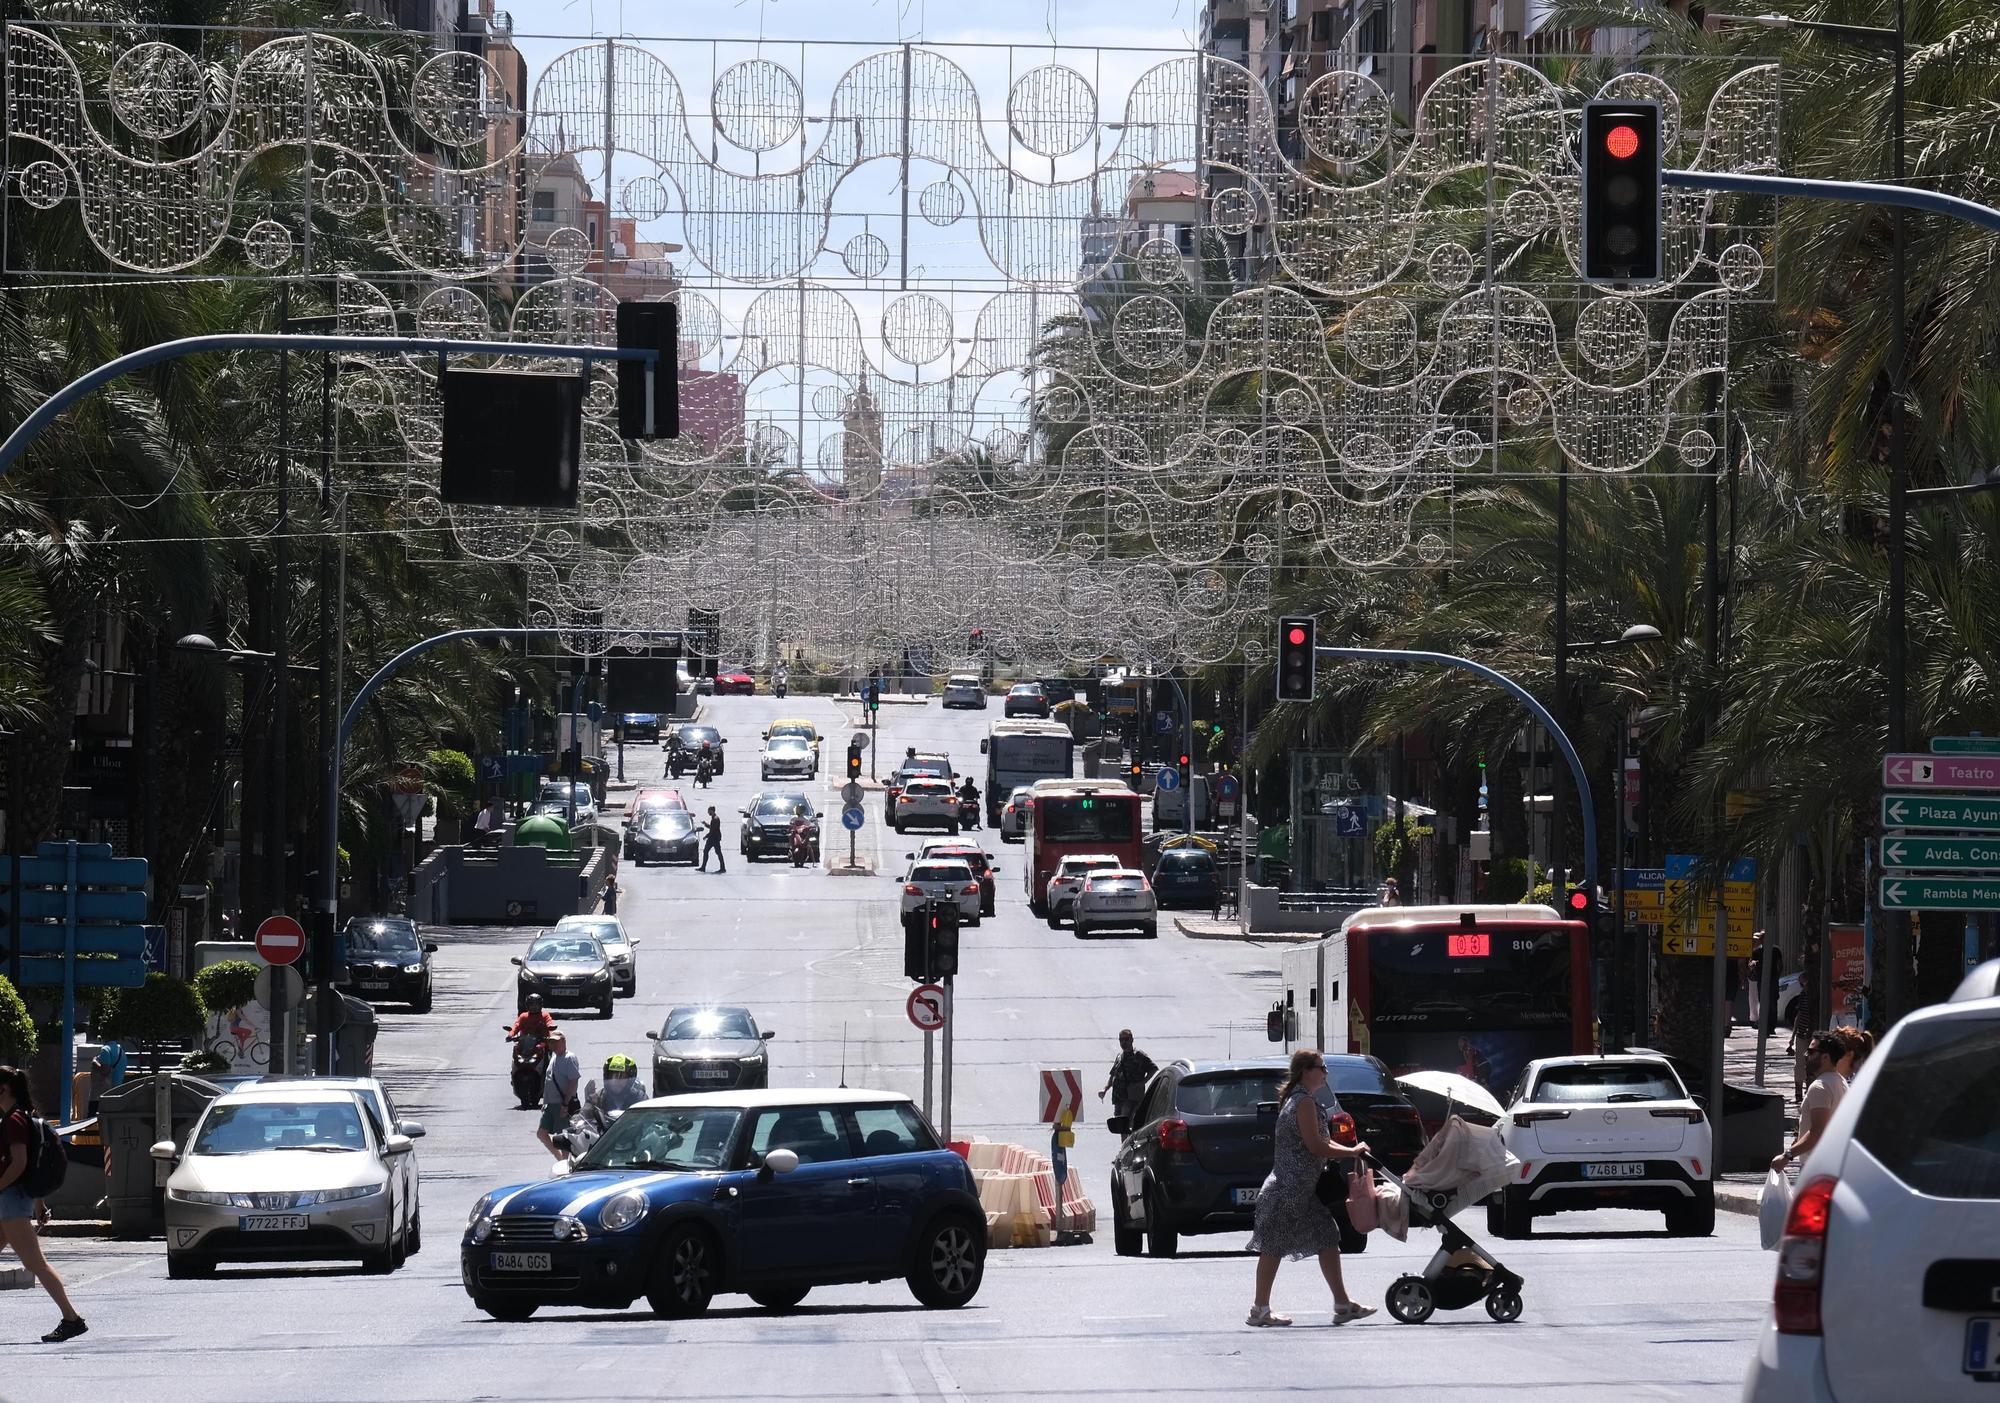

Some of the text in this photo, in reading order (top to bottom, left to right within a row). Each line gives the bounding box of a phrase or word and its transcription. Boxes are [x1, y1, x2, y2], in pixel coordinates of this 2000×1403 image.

[1948, 766, 1995, 780] Teatro
[1082, 799, 1094, 809] 01
[1919, 806, 1957, 820] Plaza
[1925, 847, 2000, 861] Avda. Con
[1923, 887, 2000, 900] Rambla Mén
[1456, 934, 1481, 955] 03
[1512, 940, 1533, 950] 810
[1375, 1014, 1429, 1022] CITARO
[1589, 1164, 1643, 1176] 7468 LWS
[248, 1217, 279, 1229] 7722
[497, 1254, 548, 1269] 8484 GGS
